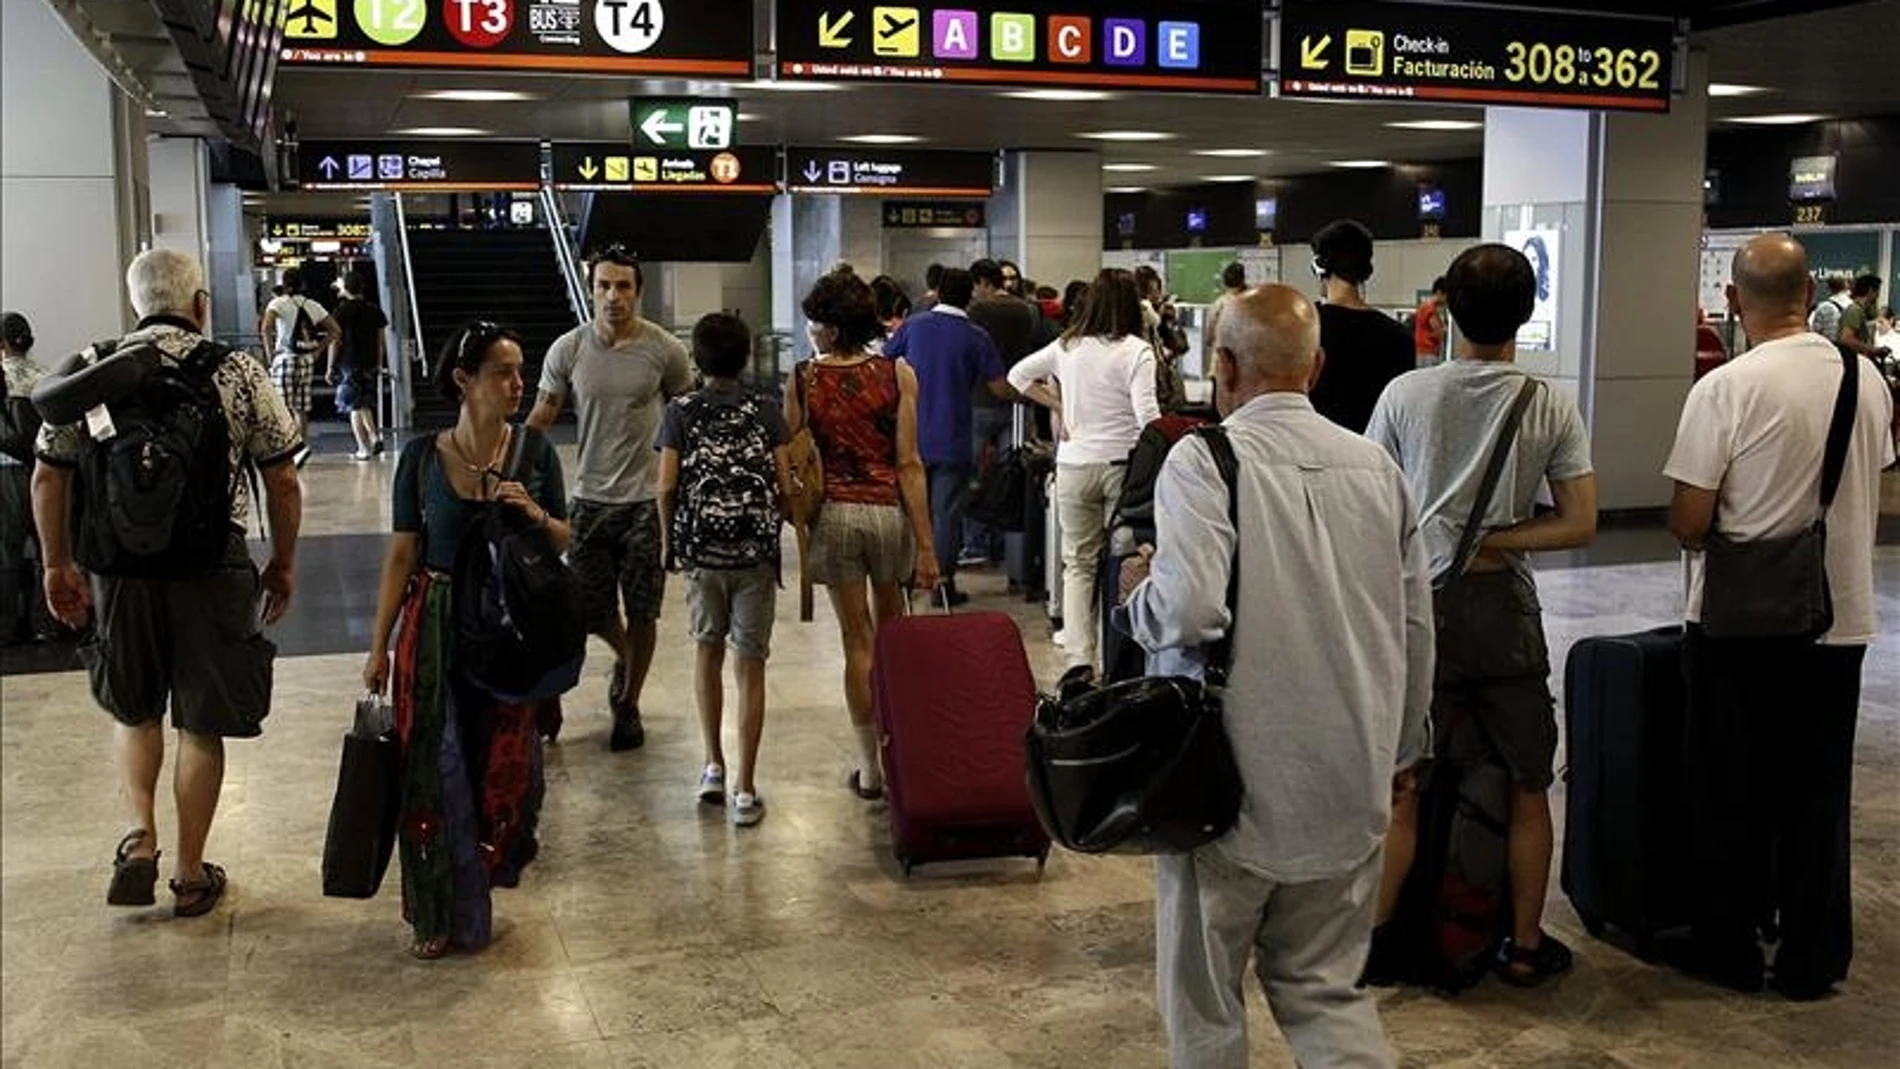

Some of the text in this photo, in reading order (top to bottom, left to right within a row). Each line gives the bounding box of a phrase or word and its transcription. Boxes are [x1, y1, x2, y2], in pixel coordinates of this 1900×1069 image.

[453, 0, 507, 33] T3
[529, 9, 557, 29] BUS
[603, 1, 655, 37] T4
[943, 19, 1187, 60] A B C D E
[1393, 34, 1450, 54] Check-in
[1393, 56, 1495, 81] Facturación
[1504, 41, 1660, 89] 308 to 362
[1578, 71, 1589, 86] a
